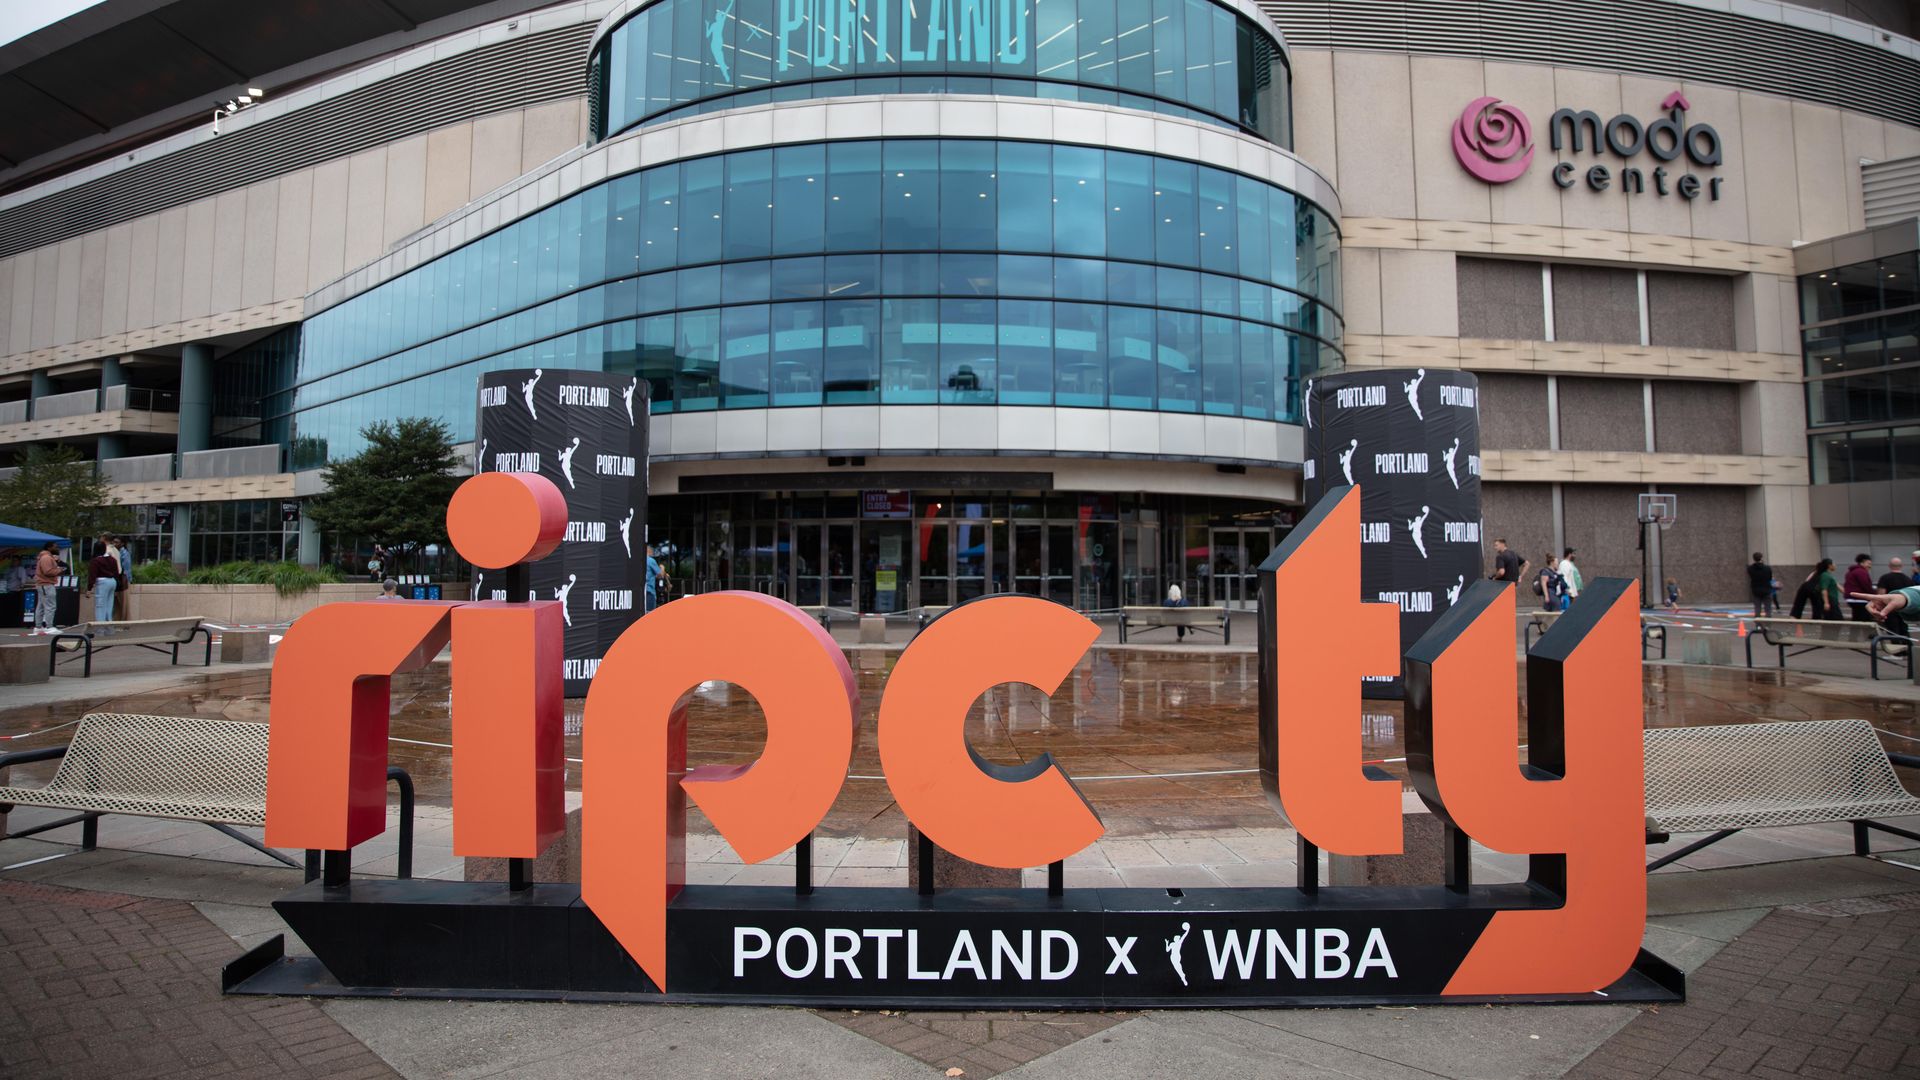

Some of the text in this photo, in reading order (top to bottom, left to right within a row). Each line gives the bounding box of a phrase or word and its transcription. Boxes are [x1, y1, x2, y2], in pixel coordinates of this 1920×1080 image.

[778, 0, 1027, 72] PORTLAND
[1550, 91, 1722, 167] moda
[1553, 161, 1723, 201] center
[481, 385, 507, 408] ORTLAND
[559, 385, 609, 408] PORTLAND
[1337, 385, 1387, 409] PORTLAND
[1440, 384, 1474, 408] PORTLAND
[495, 452, 540, 473] PORTLAND
[596, 454, 635, 477] PORTLAND
[1375, 453, 1429, 475] PORTLAND
[866, 502, 892, 510] CLOSED
[1360, 522, 1390, 543] TLAND
[1444, 522, 1479, 543] PORTLAND
[593, 589, 633, 610] PORTLAND
[732, 926, 1399, 982] PORTLAND x WNBA
